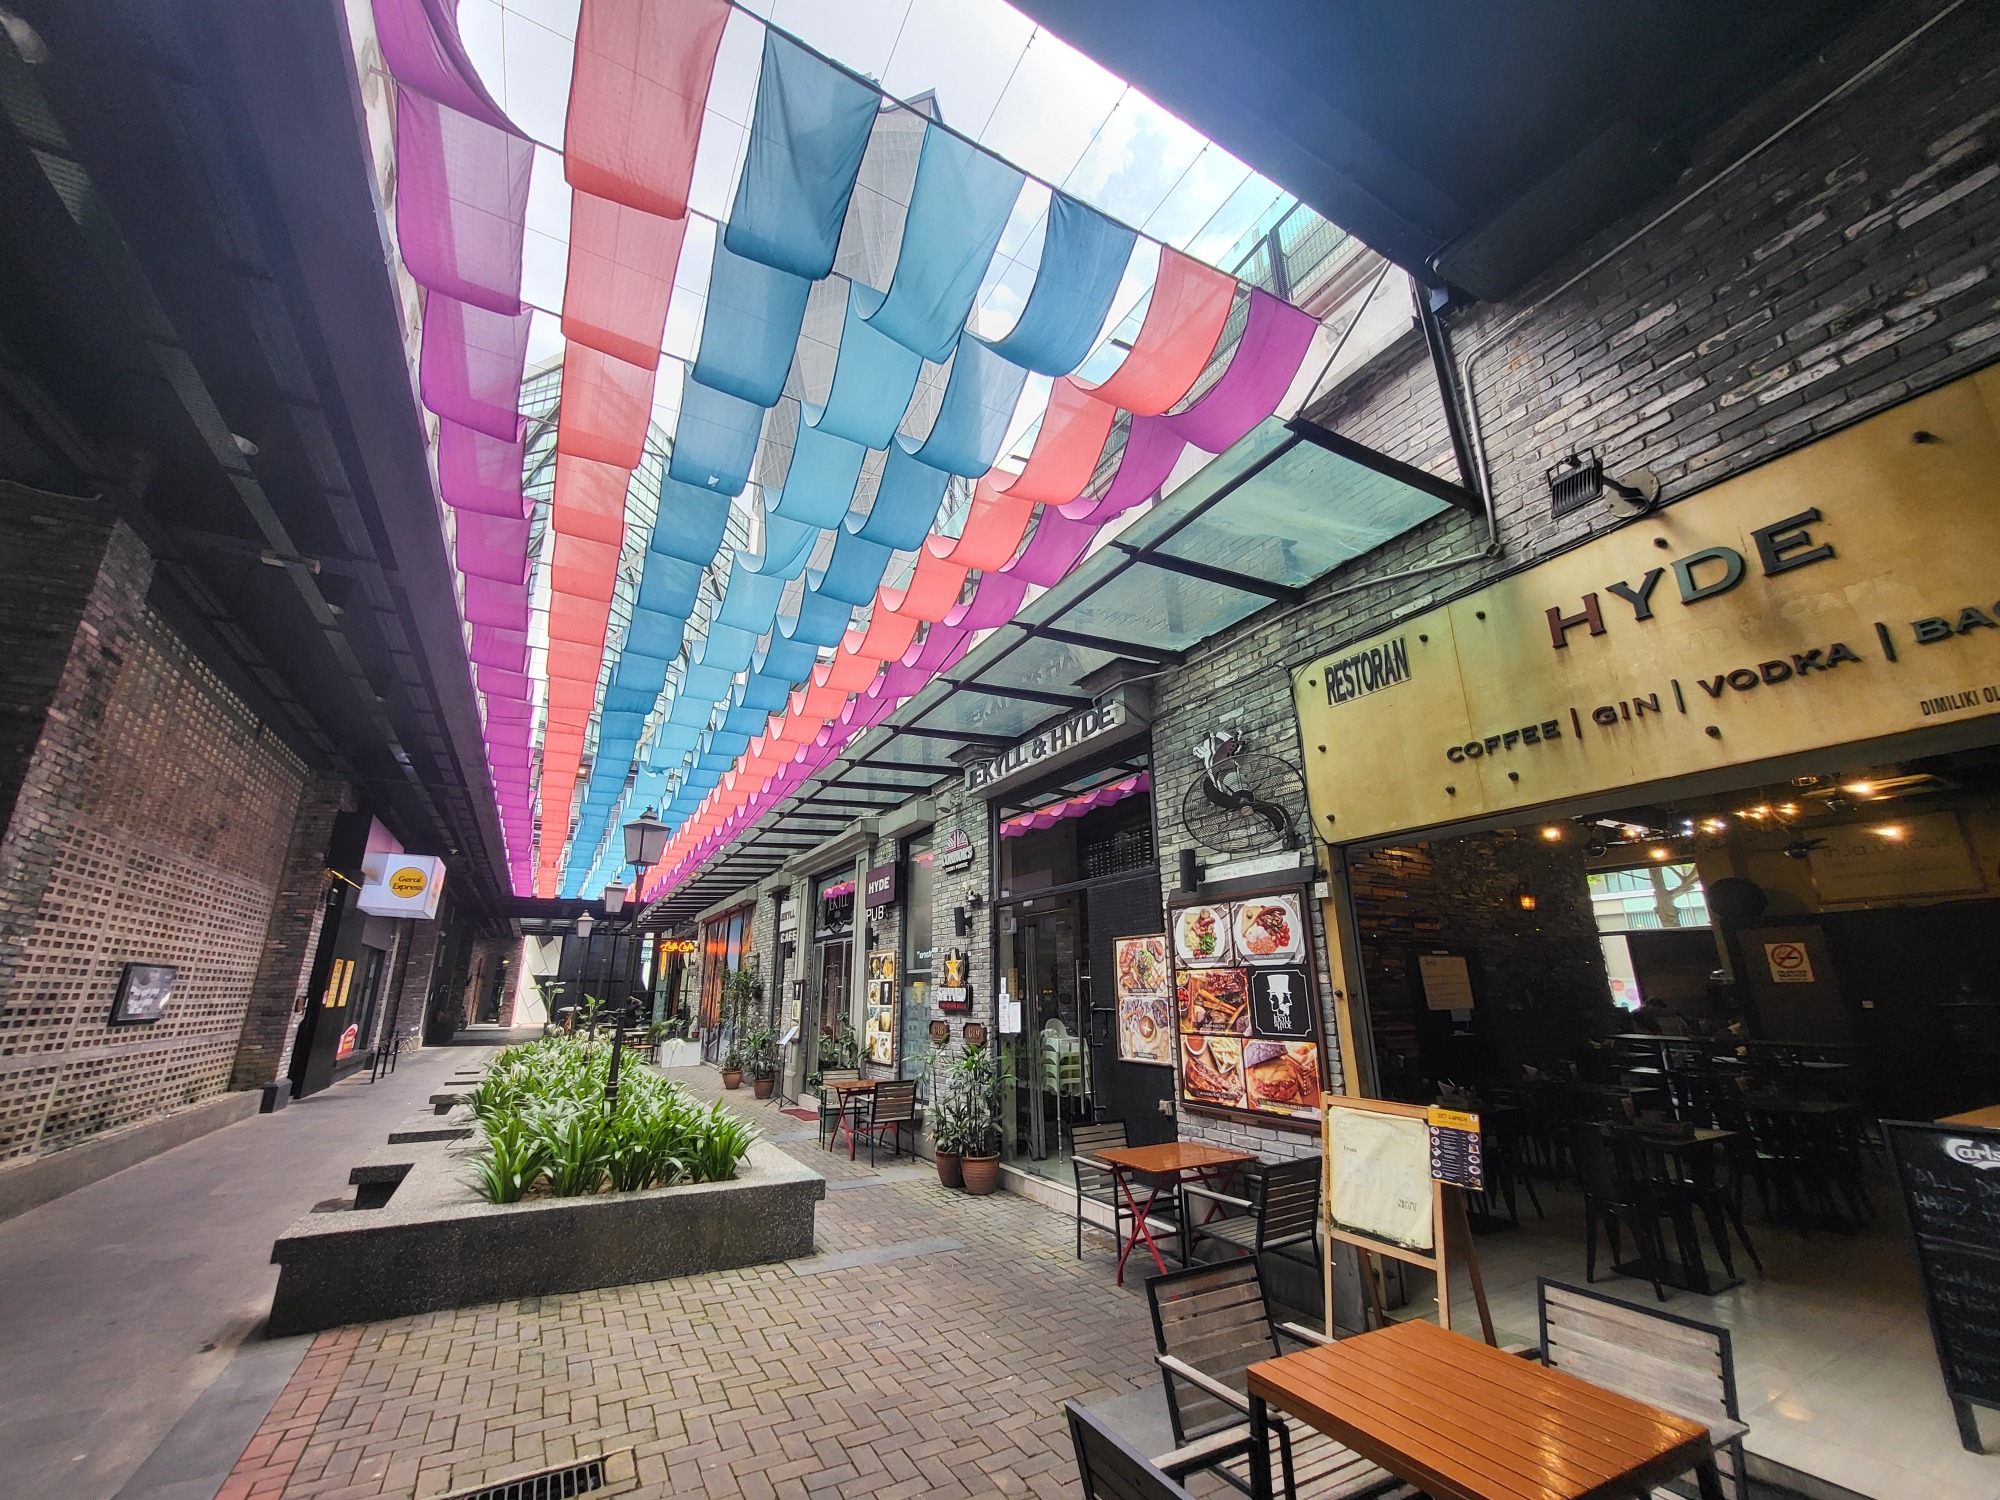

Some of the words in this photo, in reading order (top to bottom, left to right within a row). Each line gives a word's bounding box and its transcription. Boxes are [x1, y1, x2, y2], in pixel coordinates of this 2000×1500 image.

[1545, 506, 1836, 649] HYDE
[1324, 637, 1410, 706] RESTORAN
[1446, 719, 1561, 763] COFFEE
[1592, 692, 1660, 726] GIN
[1697, 642, 1862, 699] VODKA
[1920, 690, 1981, 716] DIMILIKI
[965, 746, 1029, 791] JEKYLL
[1031, 736, 1047, 759] &
[1050, 699, 1116, 752] HYDE
[392, 882, 423, 891] Express
[868, 876, 891, 895] HYDE
[866, 905, 885, 922] PUB
